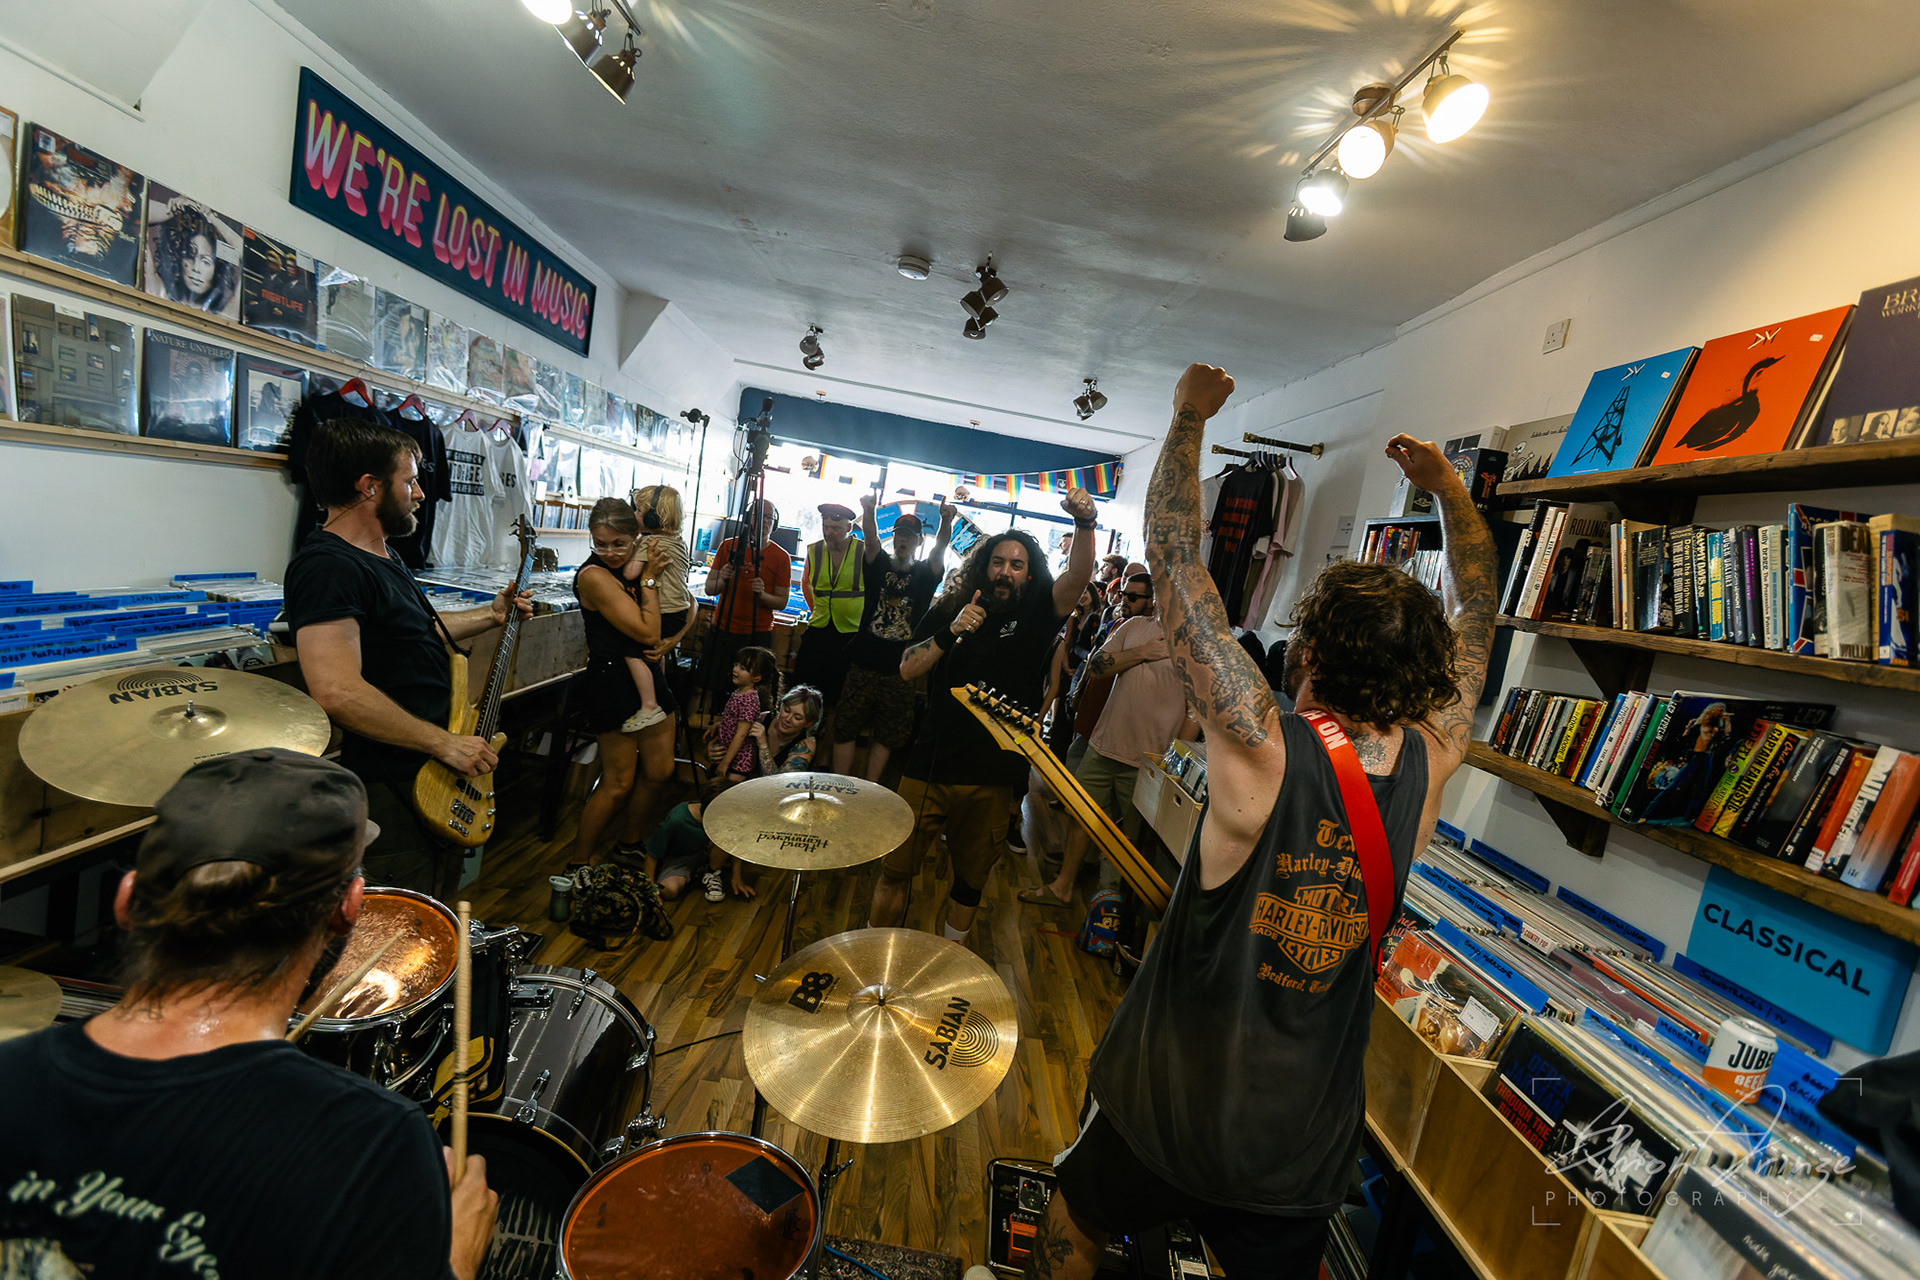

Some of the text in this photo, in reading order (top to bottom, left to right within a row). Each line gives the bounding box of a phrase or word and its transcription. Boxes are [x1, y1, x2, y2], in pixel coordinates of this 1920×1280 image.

[304, 98, 590, 340] WE'RE LOST IN MUSIC
[1883, 287, 1920, 310] BR
[151, 332, 187, 349] NATURE
[1569, 517, 1605, 538] ROLLING
[1695, 531, 1705, 561] SAMMY
[1696, 562, 1706, 585] DAVIS
[1, 652, 26, 664] DEEP
[109, 680, 219, 704] SABIAN
[1318, 720, 1349, 751] ON
[1755, 728, 1783, 766] CAPTAIN
[785, 781, 860, 796] SABIAN
[1727, 765, 1762, 814] FANTASTIC
[756, 832, 828, 849] Hammered
[780, 841, 816, 853] Hand
[1256, 900, 1369, 943] HARLEY-DAVIDSO
[1285, 938, 1341, 970] CYCLES
[1703, 902, 1871, 996] CLASSICAL
[788, 970, 834, 1015] B8
[1698, 969, 1763, 1012] SOUNDTRACKS
[1774, 1011, 1788, 1025] TV
[924, 997, 971, 1070] SABIAN
[1506, 1062, 1566, 1120] JARMAN
[1527, 1053, 1577, 1103] DEREK
[1494, 1080, 1552, 1142] THROUGH THE
[54, 1170, 166, 1222] Your
